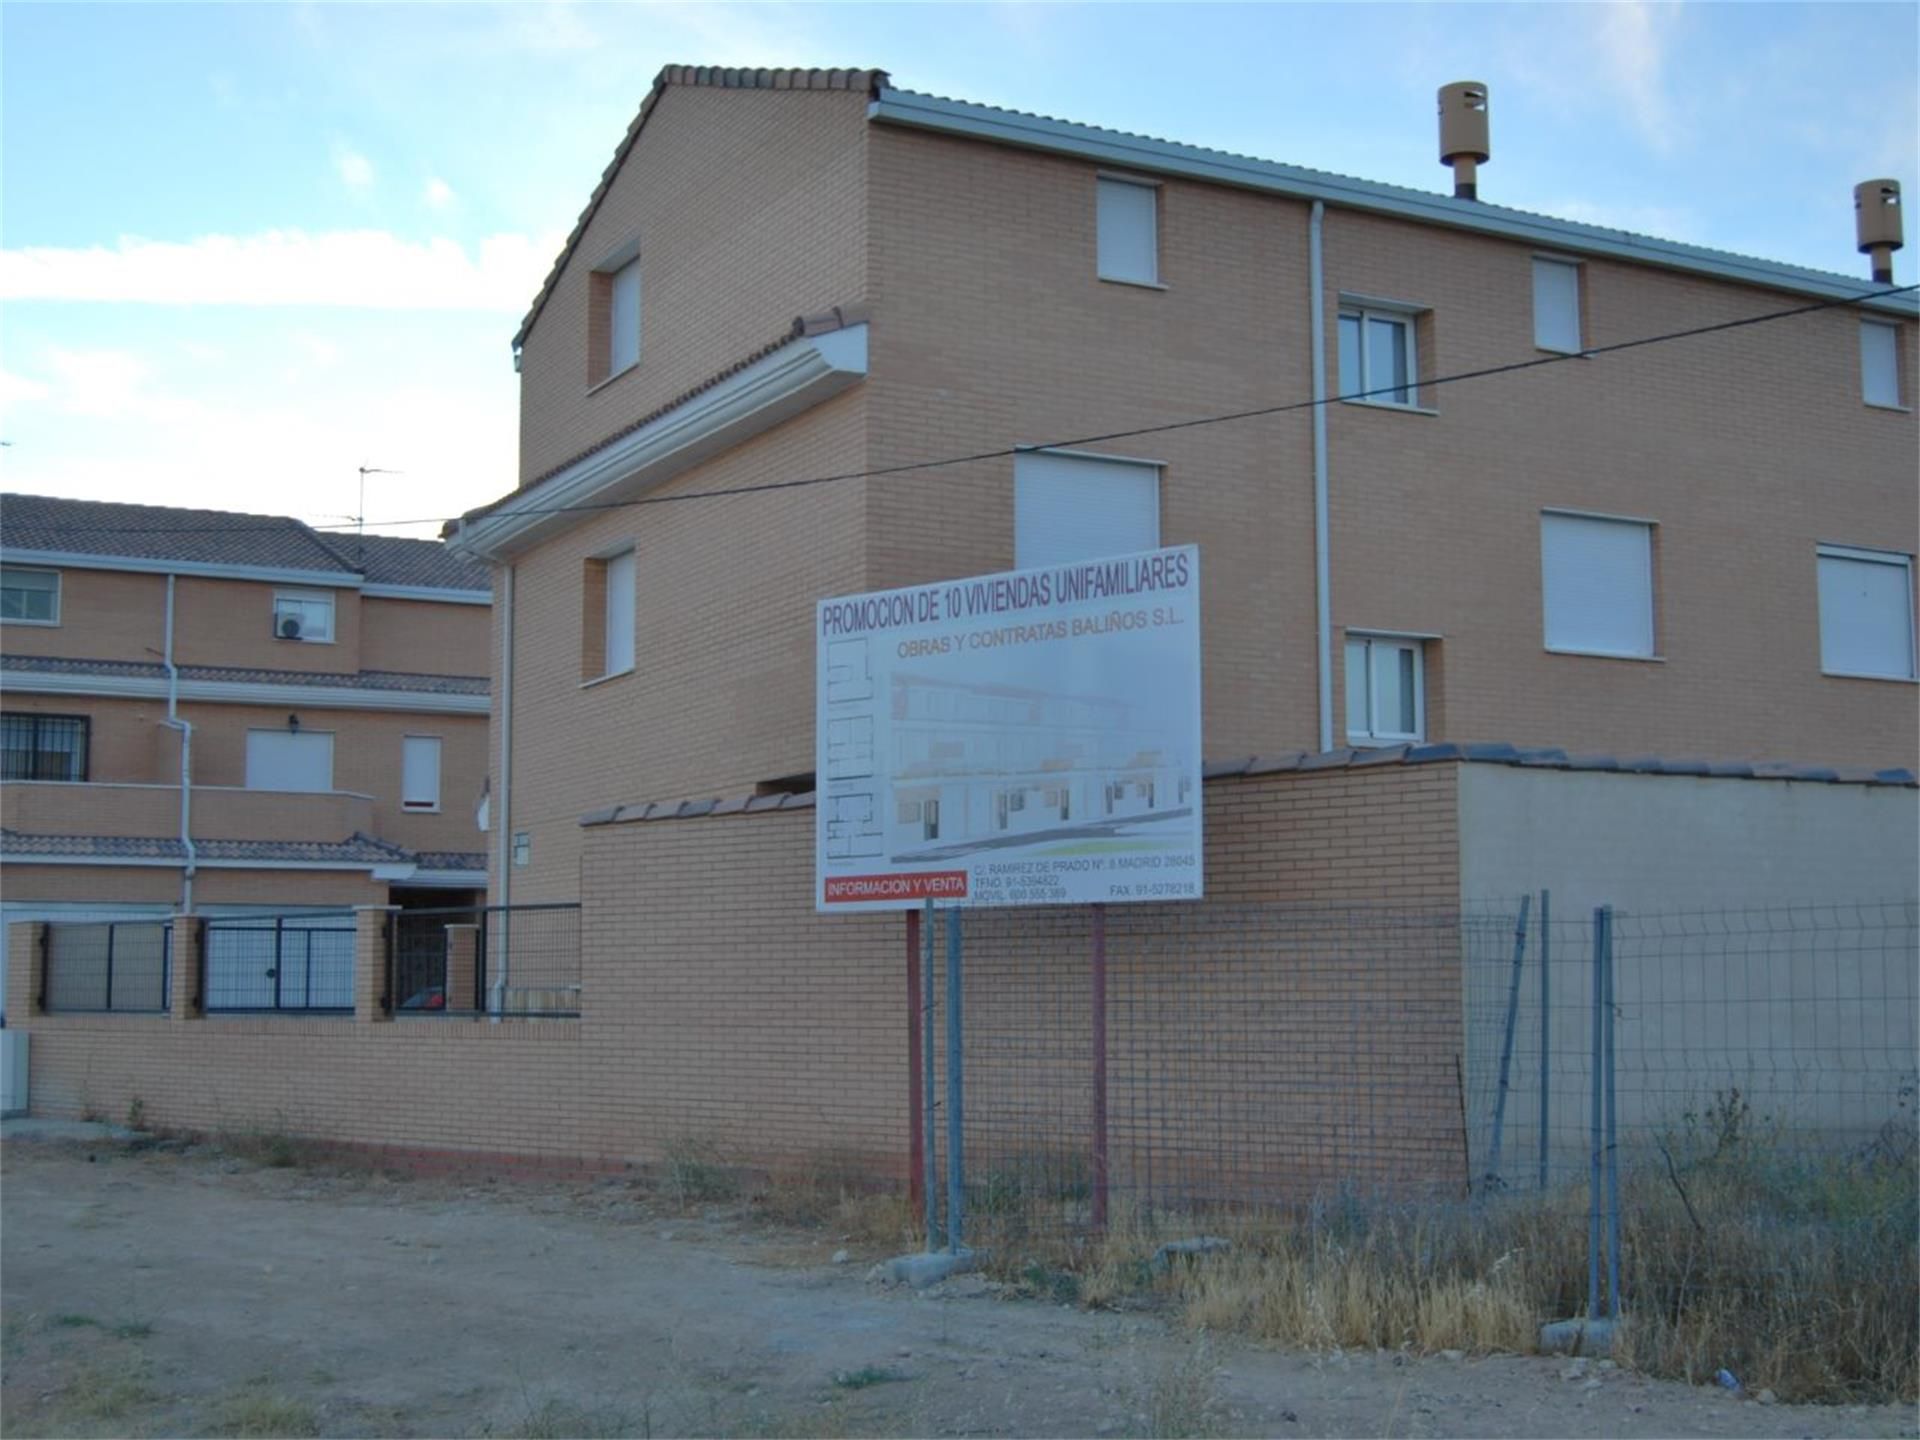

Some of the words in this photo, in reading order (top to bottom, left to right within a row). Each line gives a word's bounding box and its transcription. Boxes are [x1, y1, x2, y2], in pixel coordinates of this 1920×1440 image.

[823, 592, 914, 636] PROMOCION
[918, 589, 940, 623] DE
[945, 587, 961, 618] 10
[966, 573, 1051, 615] VIVIENDAS
[1056, 553, 1189, 603] UNIFAMILIARES
[897, 636, 950, 659] OBRAS
[953, 634, 967, 651] Y
[968, 621, 1068, 650] CONTRATAS
[1071, 610, 1147, 637] BALIÑOS
[1152, 607, 1184, 626] S.L.
[989, 862, 1033, 874] RAMIREZ
[1036, 861, 1049, 873] DE
[1053, 860, 1090, 871] PRADO
[1118, 856, 1161, 869] MADRID
[828, 878, 910, 896] INFORMACION
[914, 879, 924, 892] Y
[923, 877, 965, 893] VENTA
